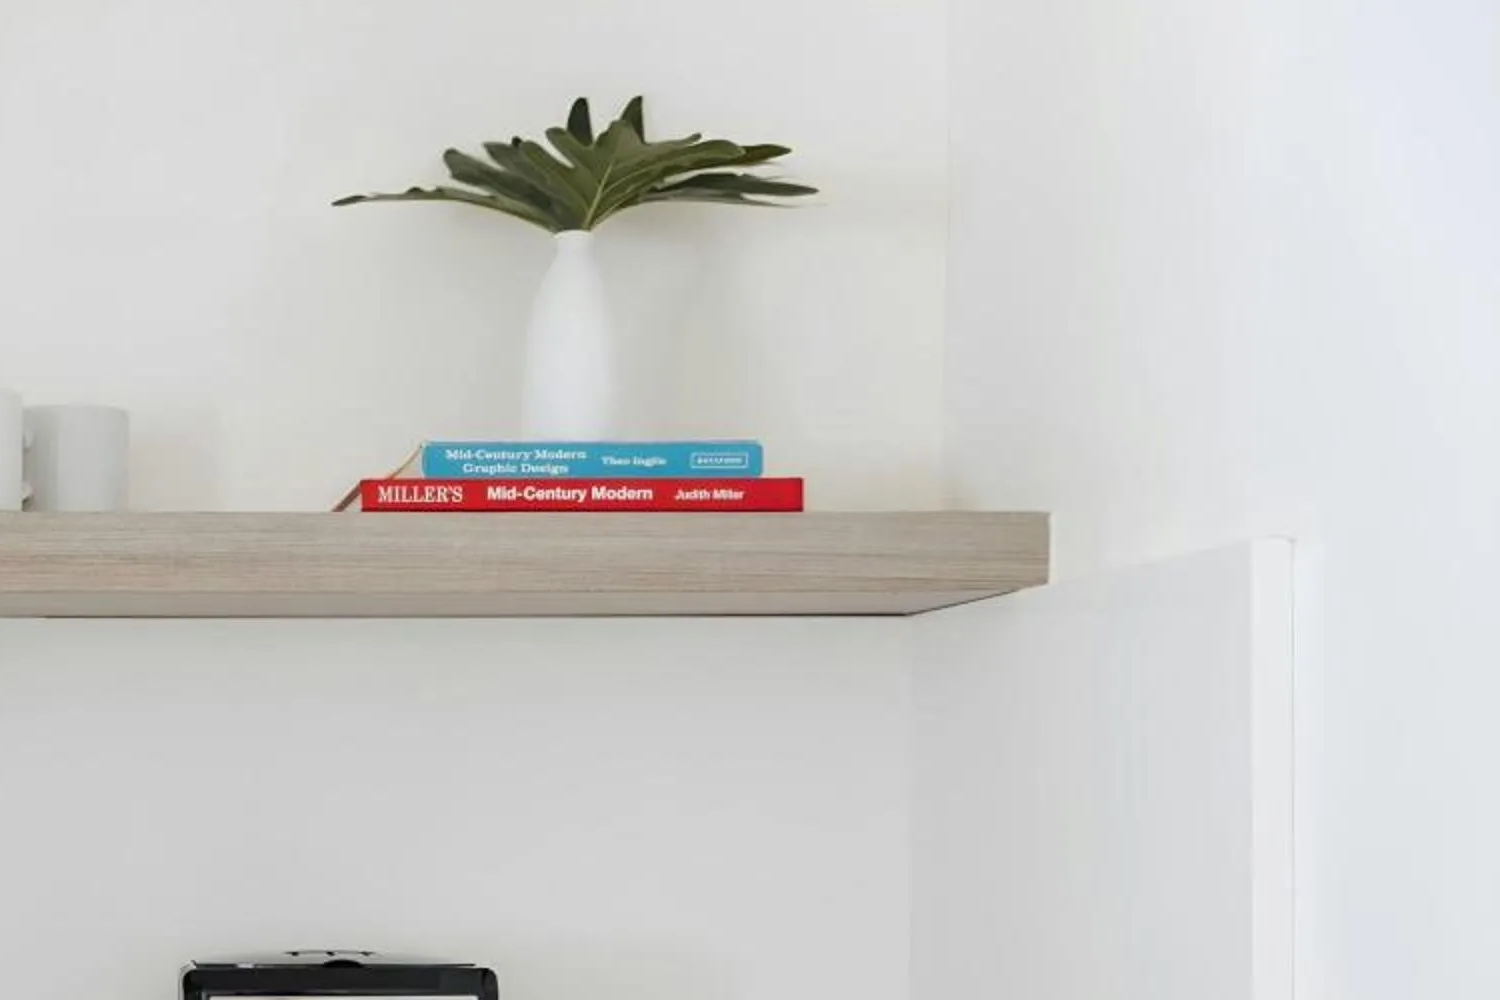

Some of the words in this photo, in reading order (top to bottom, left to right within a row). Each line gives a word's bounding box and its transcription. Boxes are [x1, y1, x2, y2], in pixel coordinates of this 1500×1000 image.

[445, 449, 534, 462] Mid-Century
[535, 449, 588, 460] Modern
[462, 463, 518, 475] Graphic
[520, 463, 570, 475] Design
[377, 485, 464, 503] MILLER'S
[487, 485, 588, 503] Mid-Century
[591, 485, 654, 501] Modern
[674, 488, 711, 501] Judith
[712, 488, 746, 501] Miller
